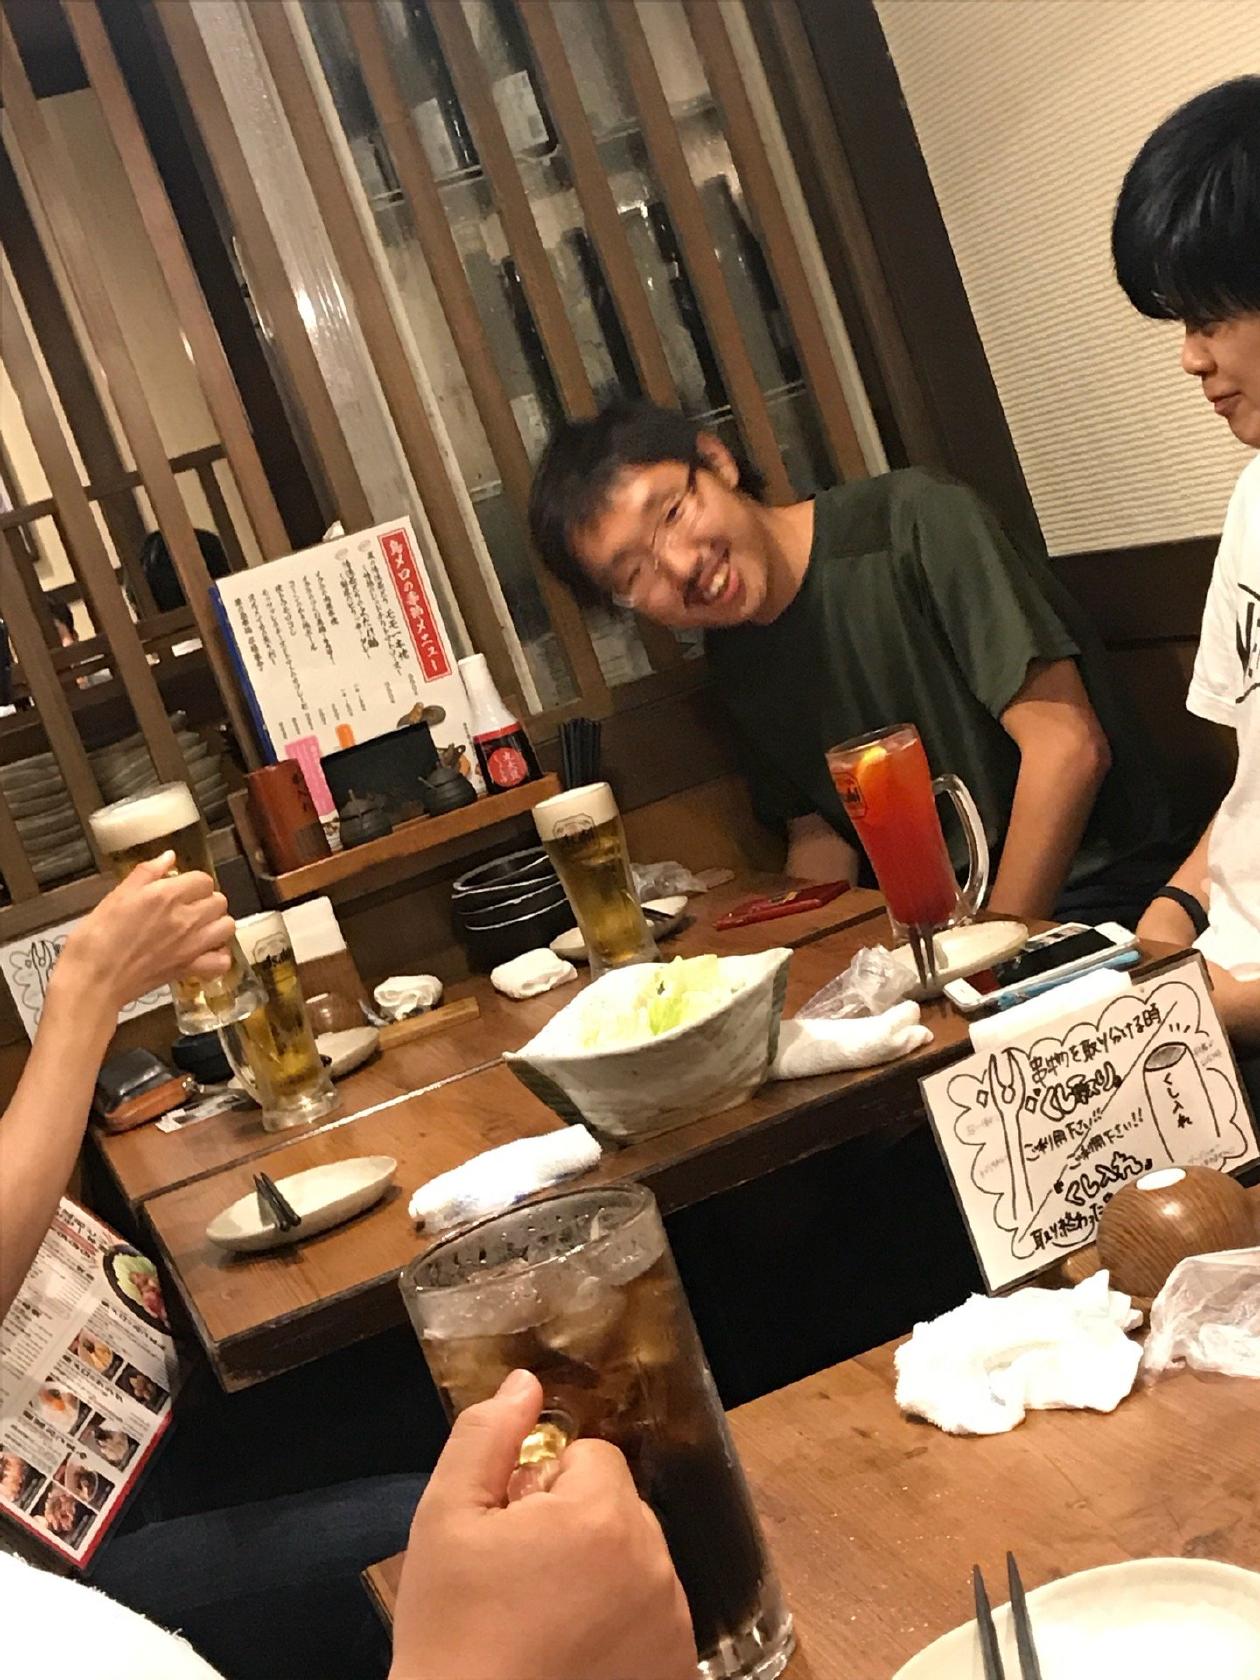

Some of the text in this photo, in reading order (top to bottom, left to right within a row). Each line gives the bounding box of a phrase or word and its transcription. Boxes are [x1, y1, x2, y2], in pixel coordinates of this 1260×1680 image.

[389, 538, 438, 672] 鳥メロの季節メニュー
[1029, 1004, 1162, 1087] 串物を取り分ける時
[1164, 1072, 1193, 1129] くし入れ
